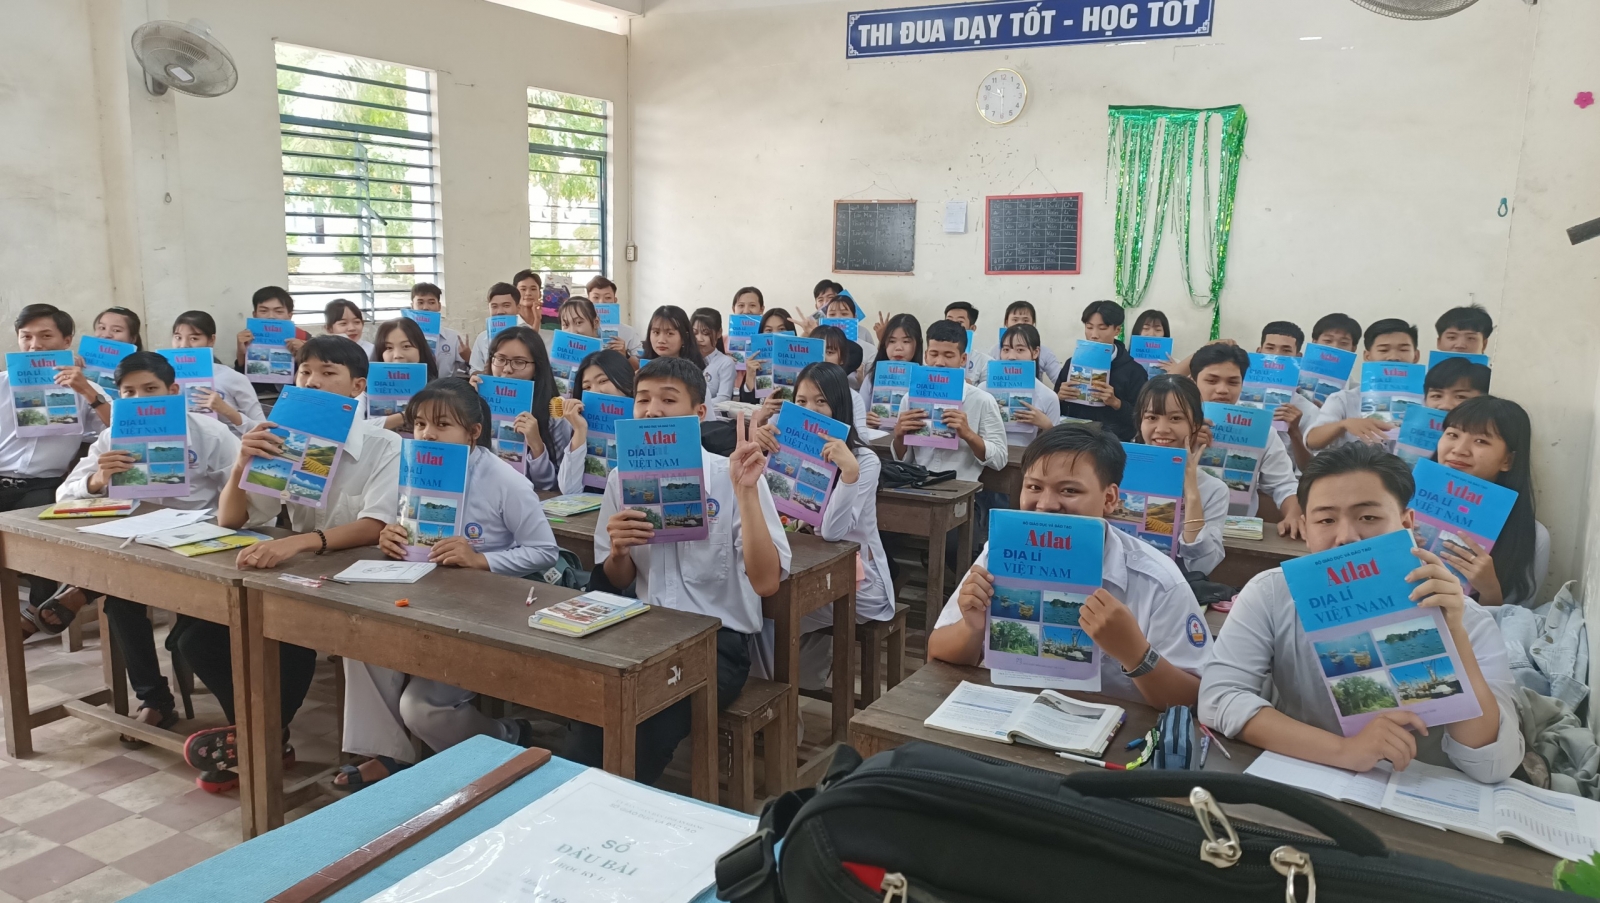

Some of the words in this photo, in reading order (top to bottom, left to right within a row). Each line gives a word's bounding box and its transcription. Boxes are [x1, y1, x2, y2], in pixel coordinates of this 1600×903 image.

[858, 24, 892, 47] THI
[900, 20, 946, 44] ĐUA
[954, 15, 1002, 45] DẠY
[1010, 2, 1056, 37] TỐT
[1082, 4, 1138, 36] HỌC
[568, 340, 586, 350] Atlat
[788, 344, 809, 353] Atlat
[30, 358, 56, 368] Atlat
[888, 366, 906, 374] Atlat
[1003, 366, 1022, 374] Atlat
[386, 371, 410, 379] Atlat
[927, 374, 949, 383] Atlat
[494, 385, 517, 398] Atlat
[135, 405, 166, 416] Atlat
[600, 402, 624, 416] Atlat
[802, 419, 828, 435] Atlat
[1224, 413, 1252, 427] Atlat
[642, 430, 677, 445] Atlat
[416, 451, 443, 466] Atlat
[628, 449, 645, 458] ĐỊA
[648, 446, 655, 456] LÍ
[628, 458, 652, 469] VIỆT
[655, 458, 679, 467] NAM
[420, 478, 442, 488] NAM
[1418, 488, 1439, 502] ĐỊA
[1442, 497, 1454, 506] LÍ
[1443, 480, 1483, 505] Atlat
[1415, 499, 1443, 516] VIỆT
[1444, 510, 1473, 528] NAM
[1025, 530, 1072, 550] Atlat
[1003, 548, 1027, 561] ĐỊA
[1031, 550, 1042, 561] LÍ
[1003, 561, 1036, 576] VIỆT
[1039, 566, 1071, 579] NAM
[1326, 557, 1380, 586] Atlat
[1309, 594, 1338, 609] ĐỊA
[1339, 586, 1353, 601] LÍ
[1314, 605, 1352, 624] VIỆT
[1355, 595, 1395, 615] NAM
[601, 840, 634, 853] SỔ
[556, 843, 600, 864] ĐẦU
[600, 859, 639, 876] BÀI
